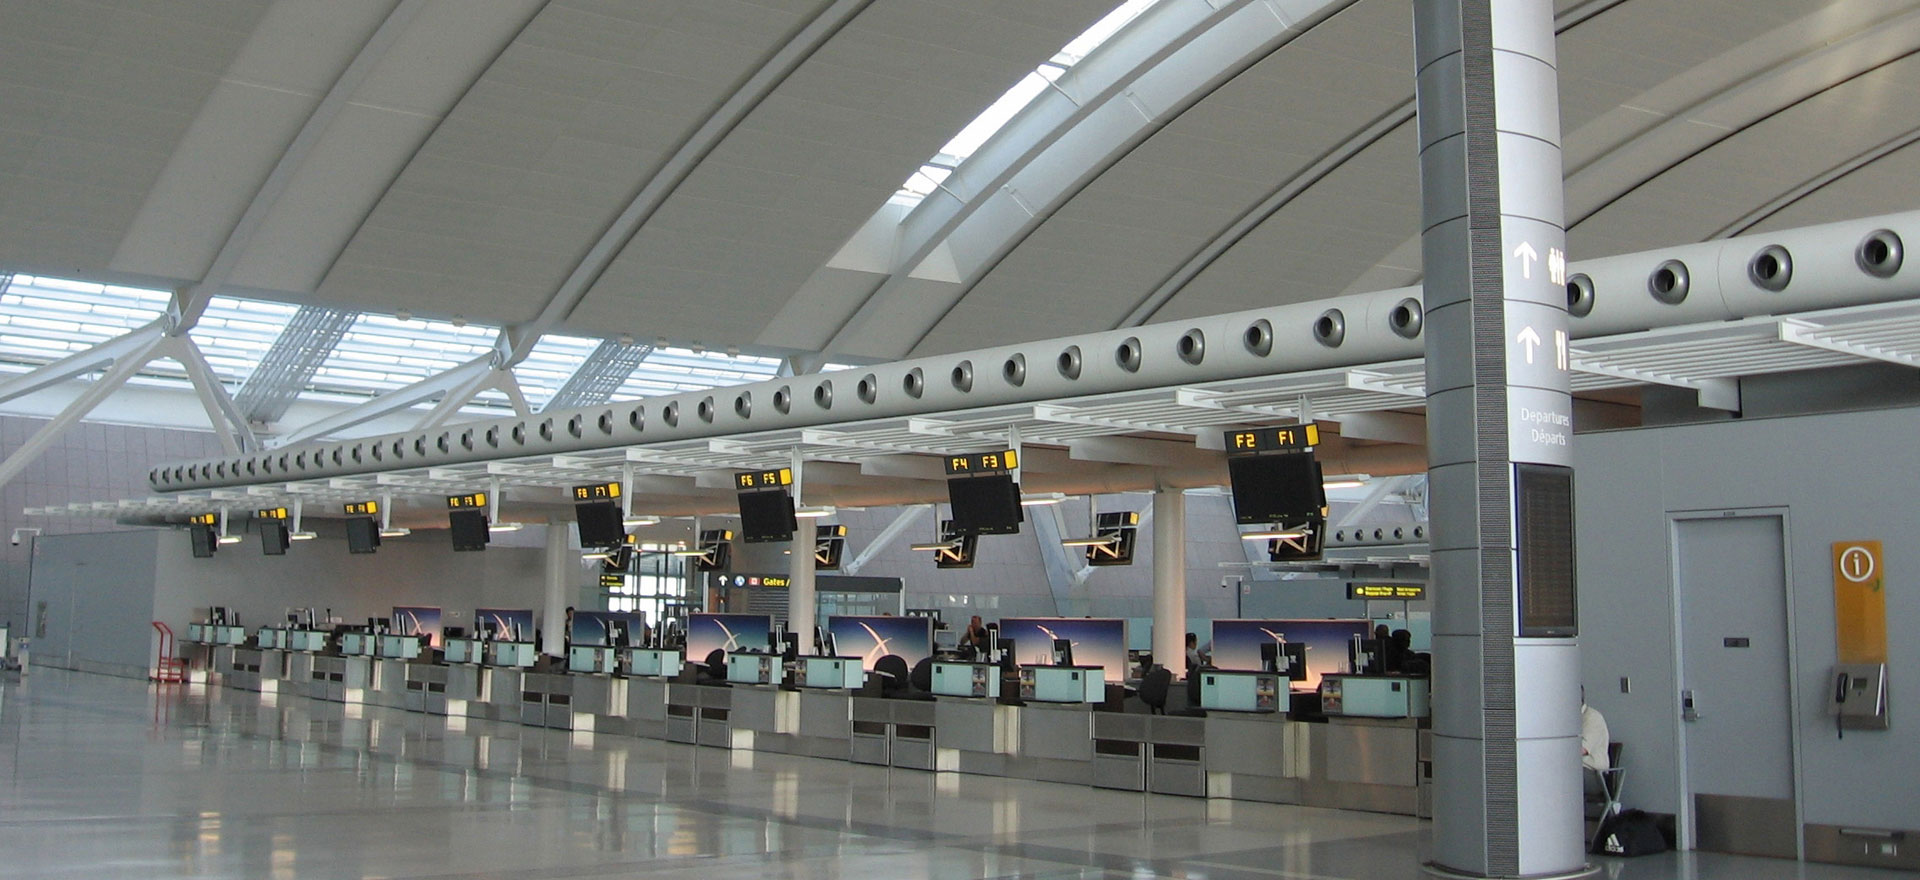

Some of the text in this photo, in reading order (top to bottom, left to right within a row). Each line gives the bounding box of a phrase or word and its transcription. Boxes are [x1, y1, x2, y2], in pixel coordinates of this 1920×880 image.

[1521, 407, 1570, 427] Departures
[1235, 430, 1294, 448] F2 F1
[1531, 428, 1566, 446] Départs
[952, 455, 998, 471] F4 F3
[741, 472, 776, 486] F6 F5
[595, 486, 606, 497] F7
[763, 577, 785, 587] Gates
